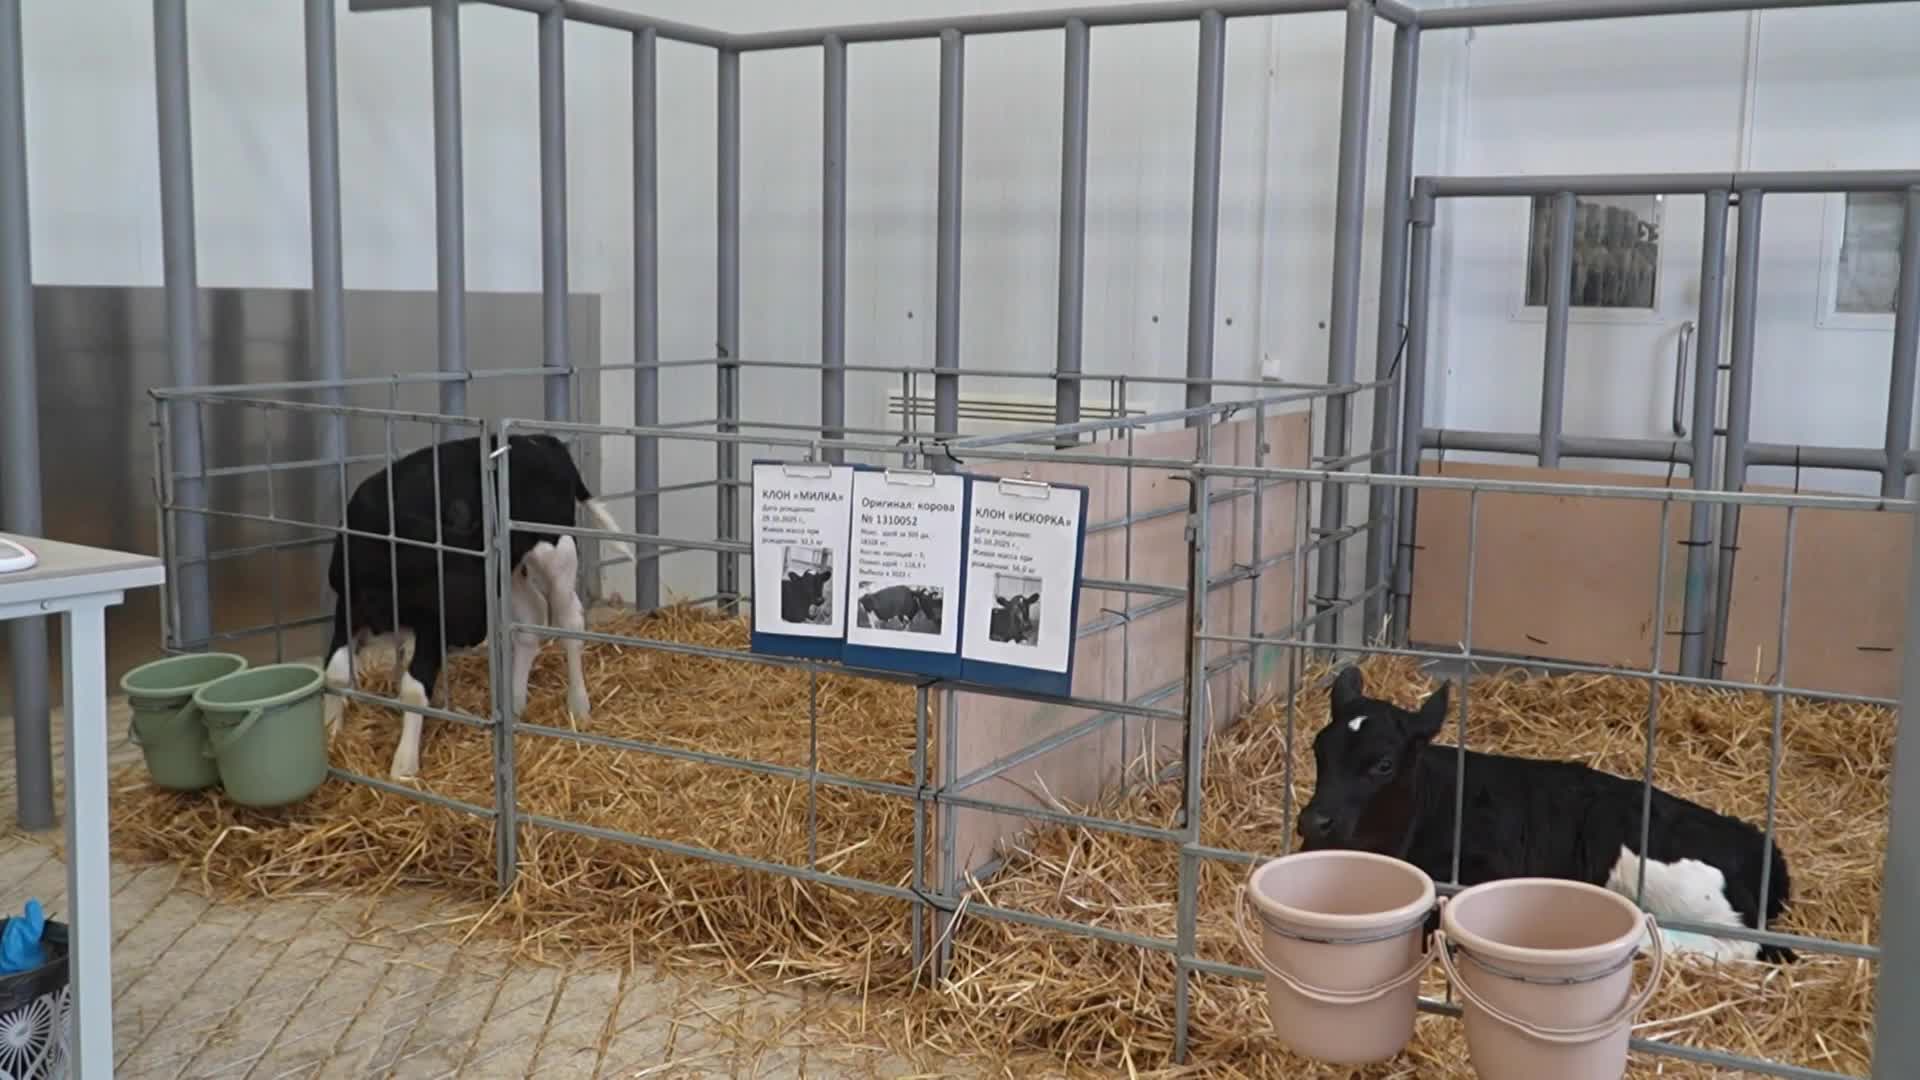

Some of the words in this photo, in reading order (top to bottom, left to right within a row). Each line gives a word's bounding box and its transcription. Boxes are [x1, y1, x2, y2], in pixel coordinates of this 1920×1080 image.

[762, 490, 790, 500] КЛОН
[794, 491, 844, 501] «МИЛКА»
[862, 497, 915, 510] Оригинал:
[918, 503, 955, 512] корова
[862, 514, 873, 524] №
[876, 514, 918, 526] 1310052
[976, 508, 1005, 520] КЛОН
[1008, 512, 1071, 526] «ИСКОРКА»
